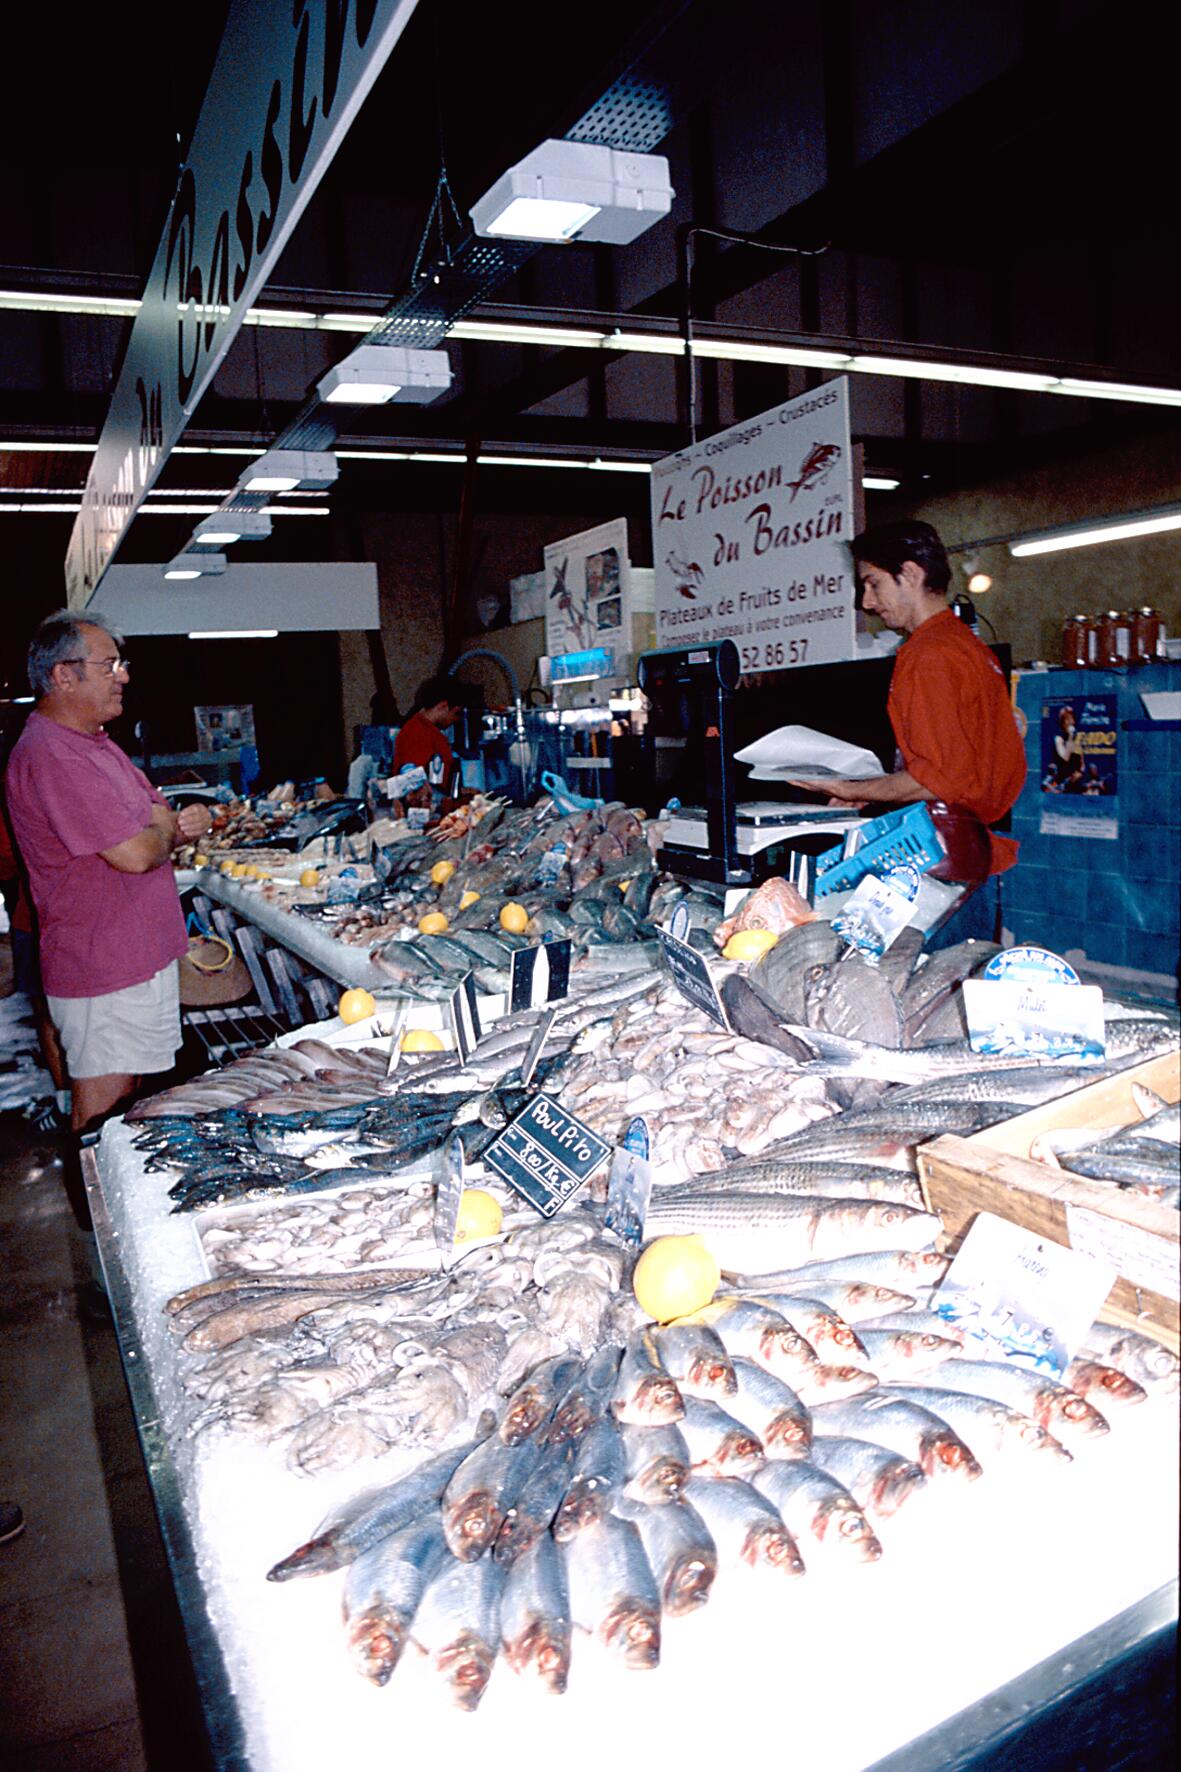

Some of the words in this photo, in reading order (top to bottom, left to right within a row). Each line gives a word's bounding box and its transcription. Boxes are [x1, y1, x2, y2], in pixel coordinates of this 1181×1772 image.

[779, 388, 839, 424] Crustacés
[658, 485, 686, 527] Le
[690, 465, 783, 514] Poisson
[714, 533, 740, 567] du
[744, 503, 842, 556] Bassin
[659, 604, 713, 628] Plateaux
[717, 596, 734, 616] de
[739, 587, 781, 612] Fruits
[787, 580, 807, 601] de
[812, 573, 844, 597] Mer
[783, 604, 845, 628] convenance
[741, 645, 760, 670] 52
[766, 641, 784, 666] 86
[789, 638, 809, 663] 57
